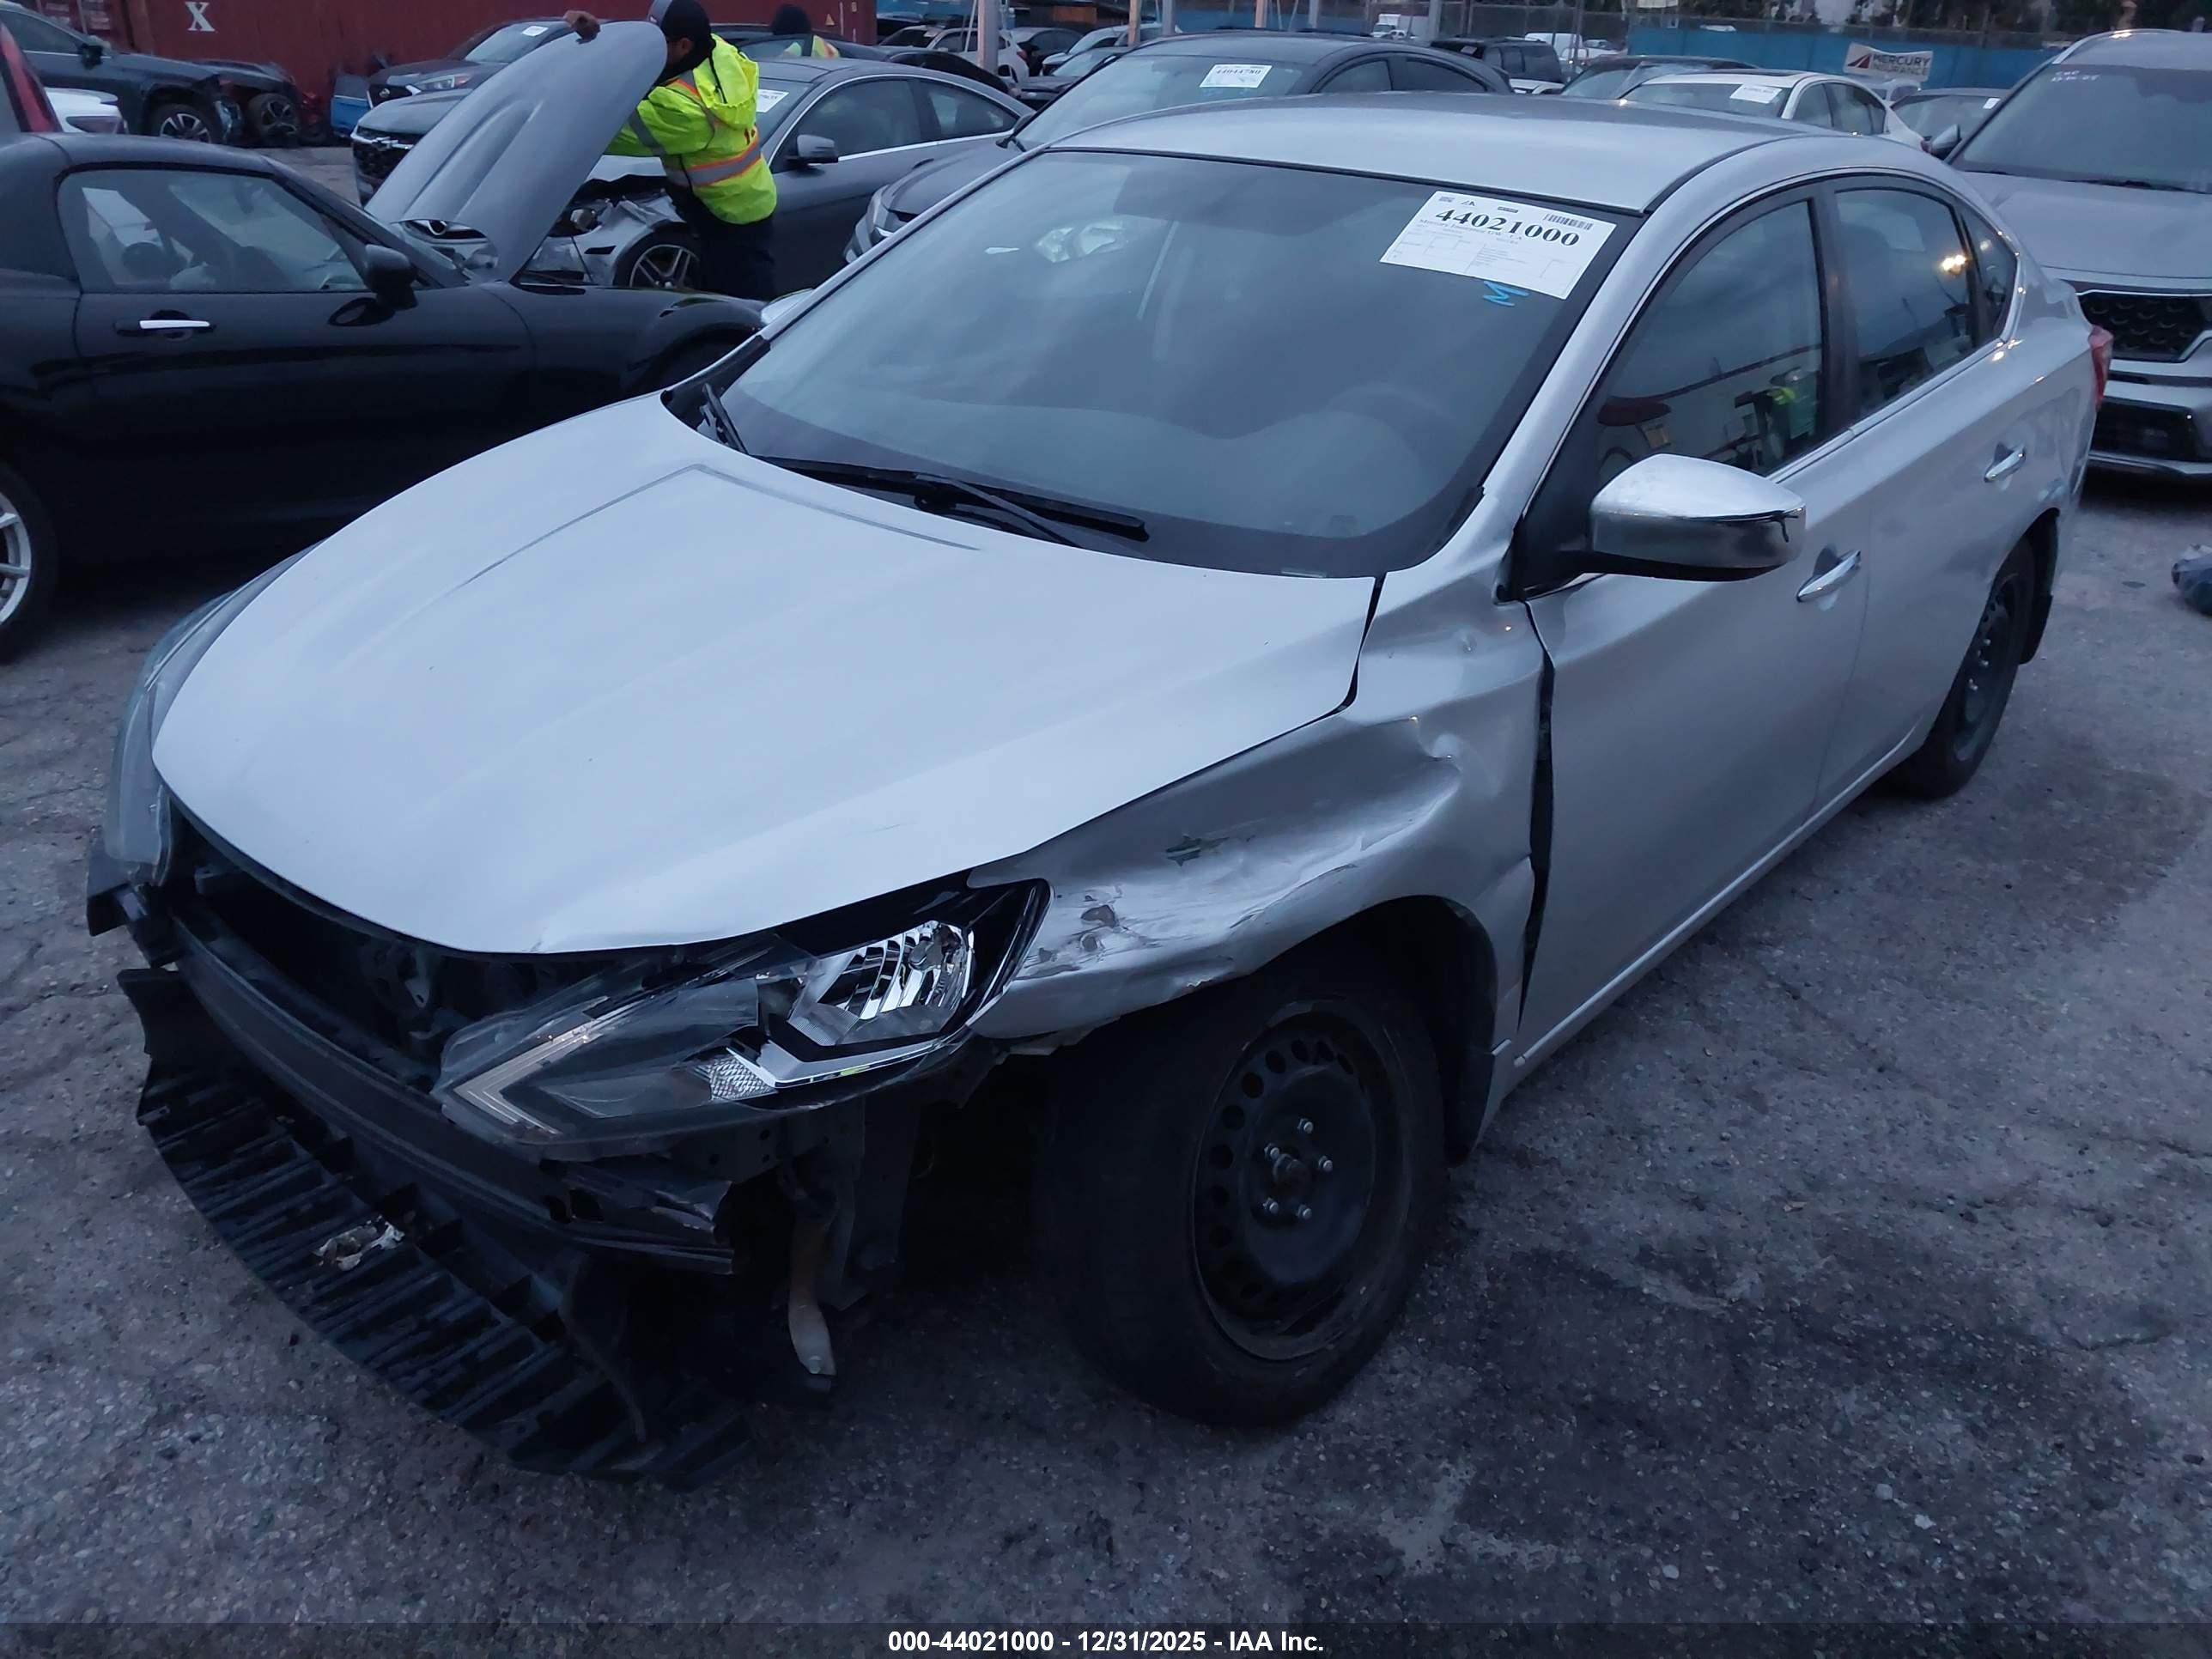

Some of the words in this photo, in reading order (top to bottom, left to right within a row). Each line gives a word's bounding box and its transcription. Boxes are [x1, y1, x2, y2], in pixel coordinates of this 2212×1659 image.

[185, 2, 215, 32] X
[1873, 54, 1931, 66] MERCURY
[1436, 208, 1580, 246] 44021000
